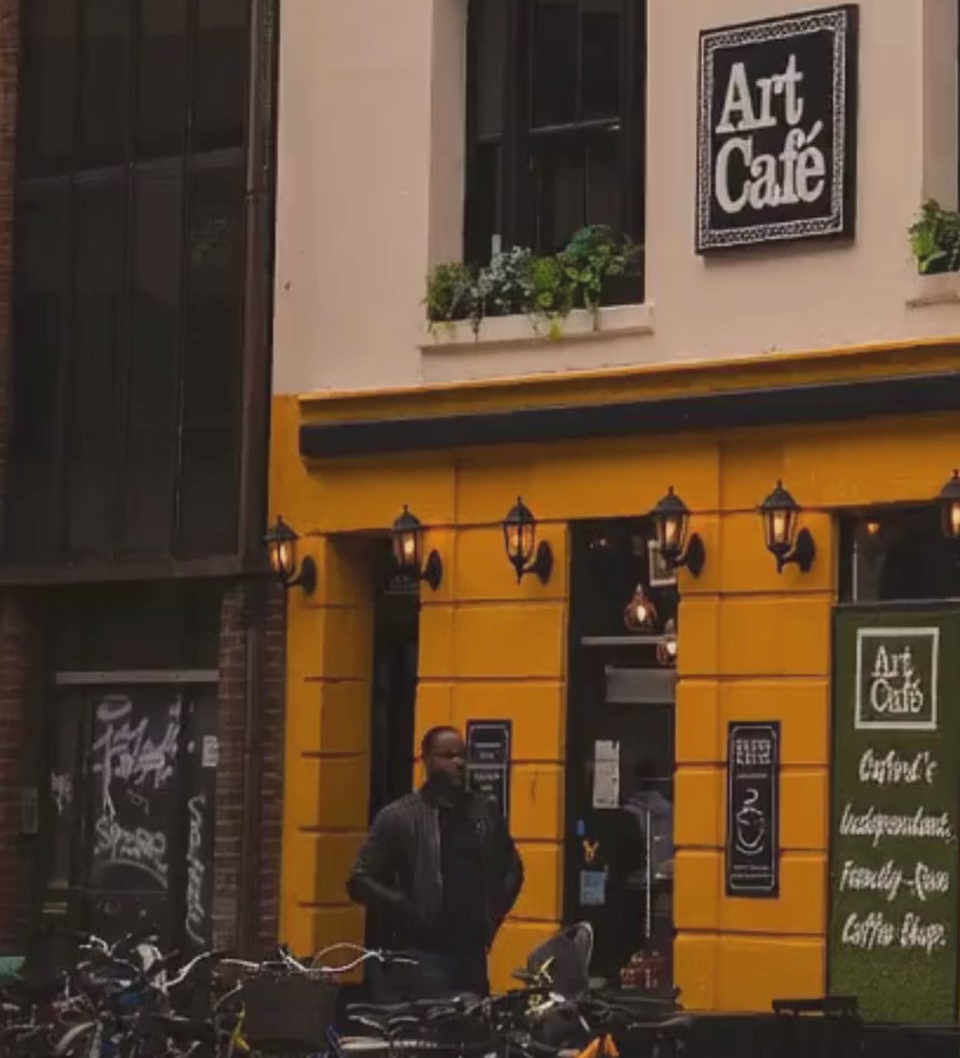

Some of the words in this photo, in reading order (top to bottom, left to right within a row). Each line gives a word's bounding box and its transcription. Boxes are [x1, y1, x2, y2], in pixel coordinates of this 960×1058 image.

[715, 54, 804, 134] Art
[715, 120, 826, 214] Café
[870, 645, 913, 678] Art
[870, 677, 924, 713] Café
